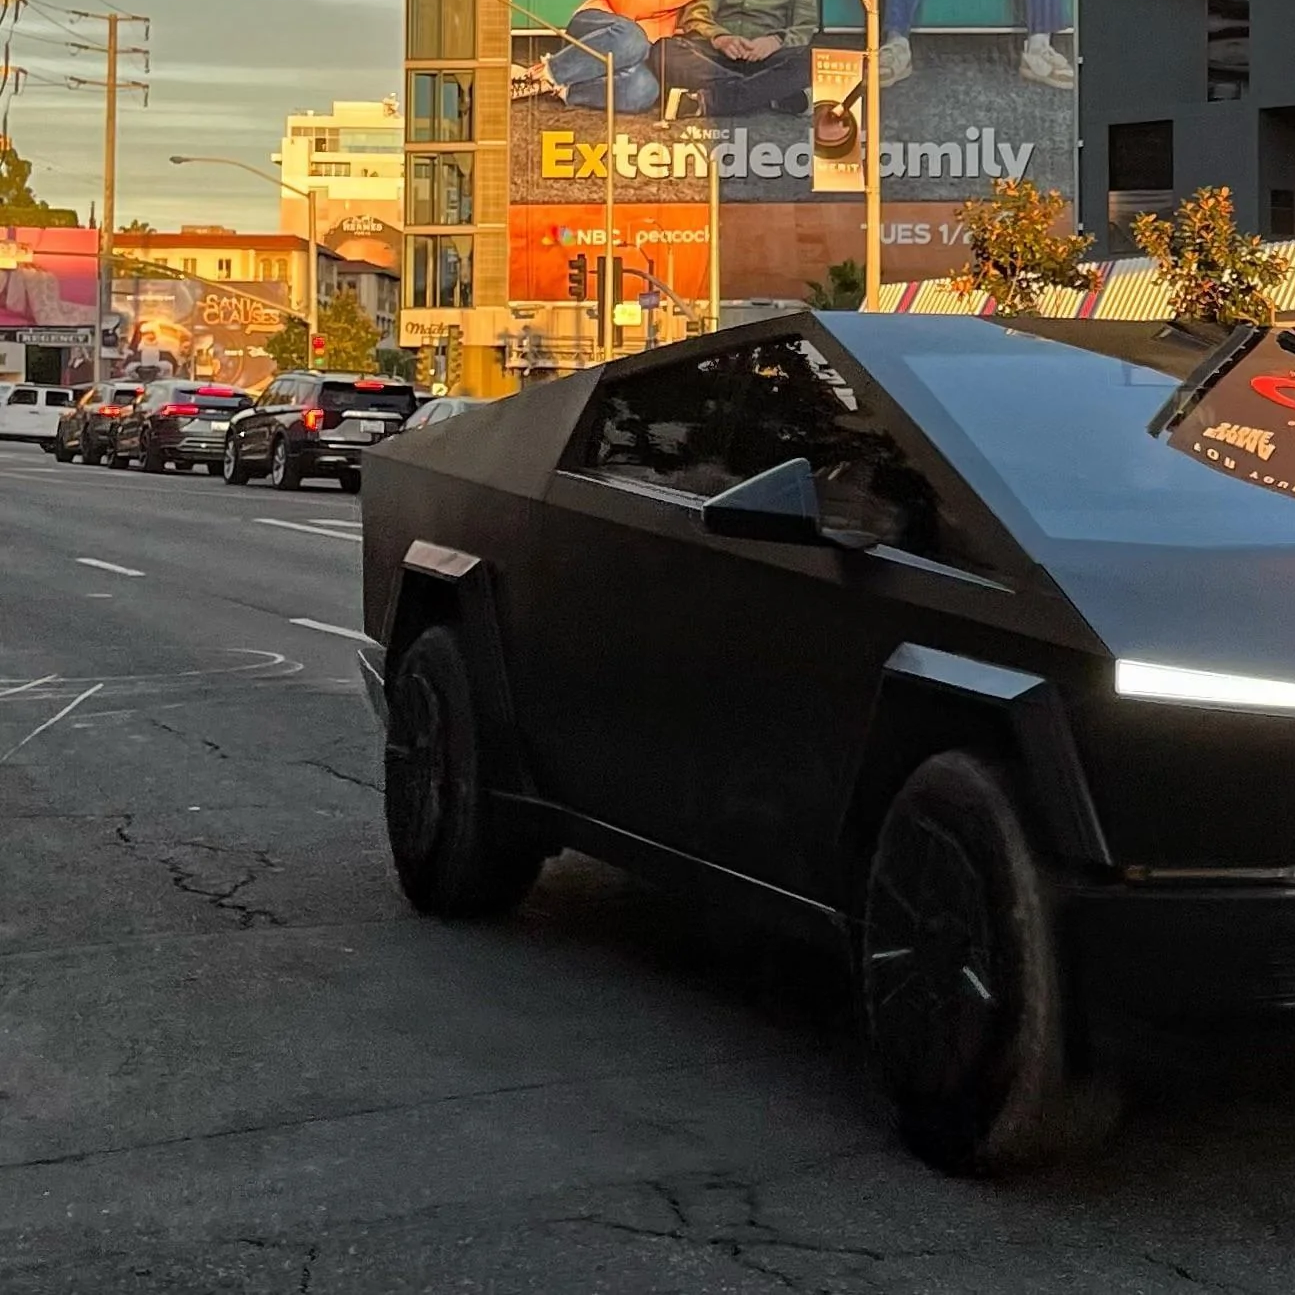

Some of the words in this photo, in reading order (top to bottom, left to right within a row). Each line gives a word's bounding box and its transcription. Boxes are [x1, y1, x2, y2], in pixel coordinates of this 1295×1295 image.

[703, 128, 730, 140] NBC
[861, 126, 1035, 187] amily
[860, 222, 931, 245] UES
[203, 307, 280, 325] CLAUSES
